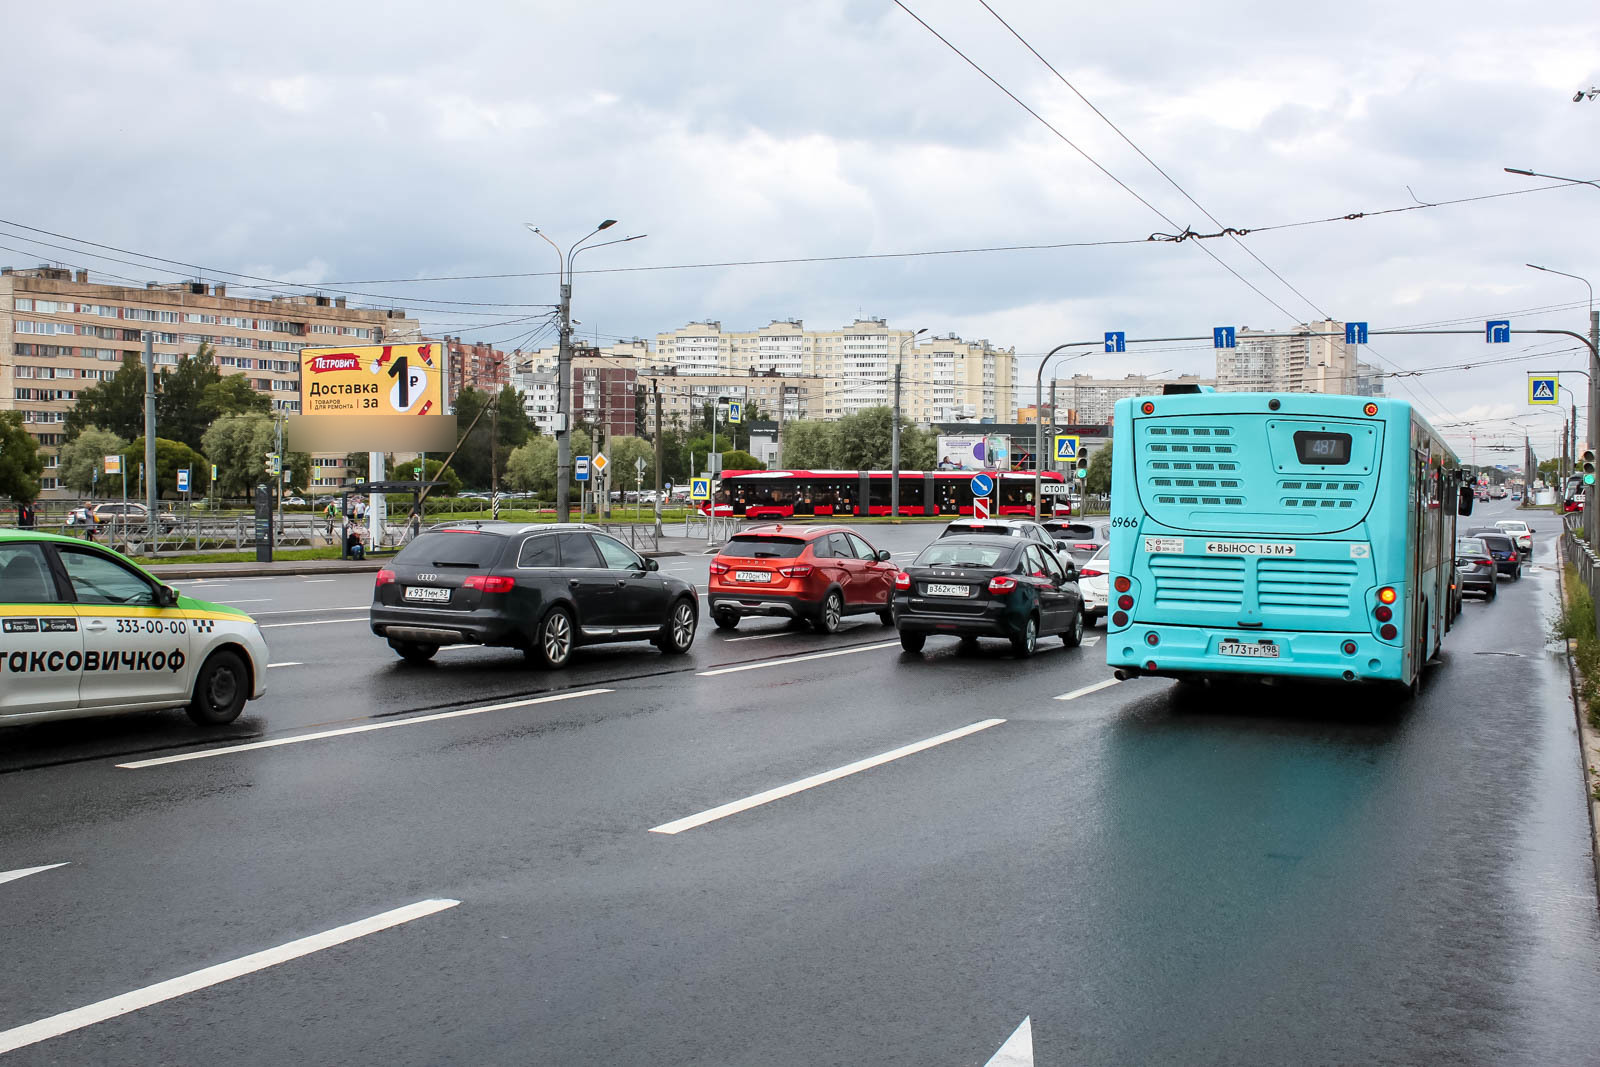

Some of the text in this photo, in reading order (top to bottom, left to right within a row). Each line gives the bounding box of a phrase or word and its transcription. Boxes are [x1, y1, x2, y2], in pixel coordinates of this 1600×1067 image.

[309, 382, 379, 397] Доставка
[387, 356, 409, 408] 1
[363, 398, 378, 408] за
[1312, 440, 1336, 455] 487
[1112, 516, 1138, 528] 6966
[1217, 543, 1285, 555] ВЫНОС 1.5 М
[116, 619, 187, 634] 333-00-00
